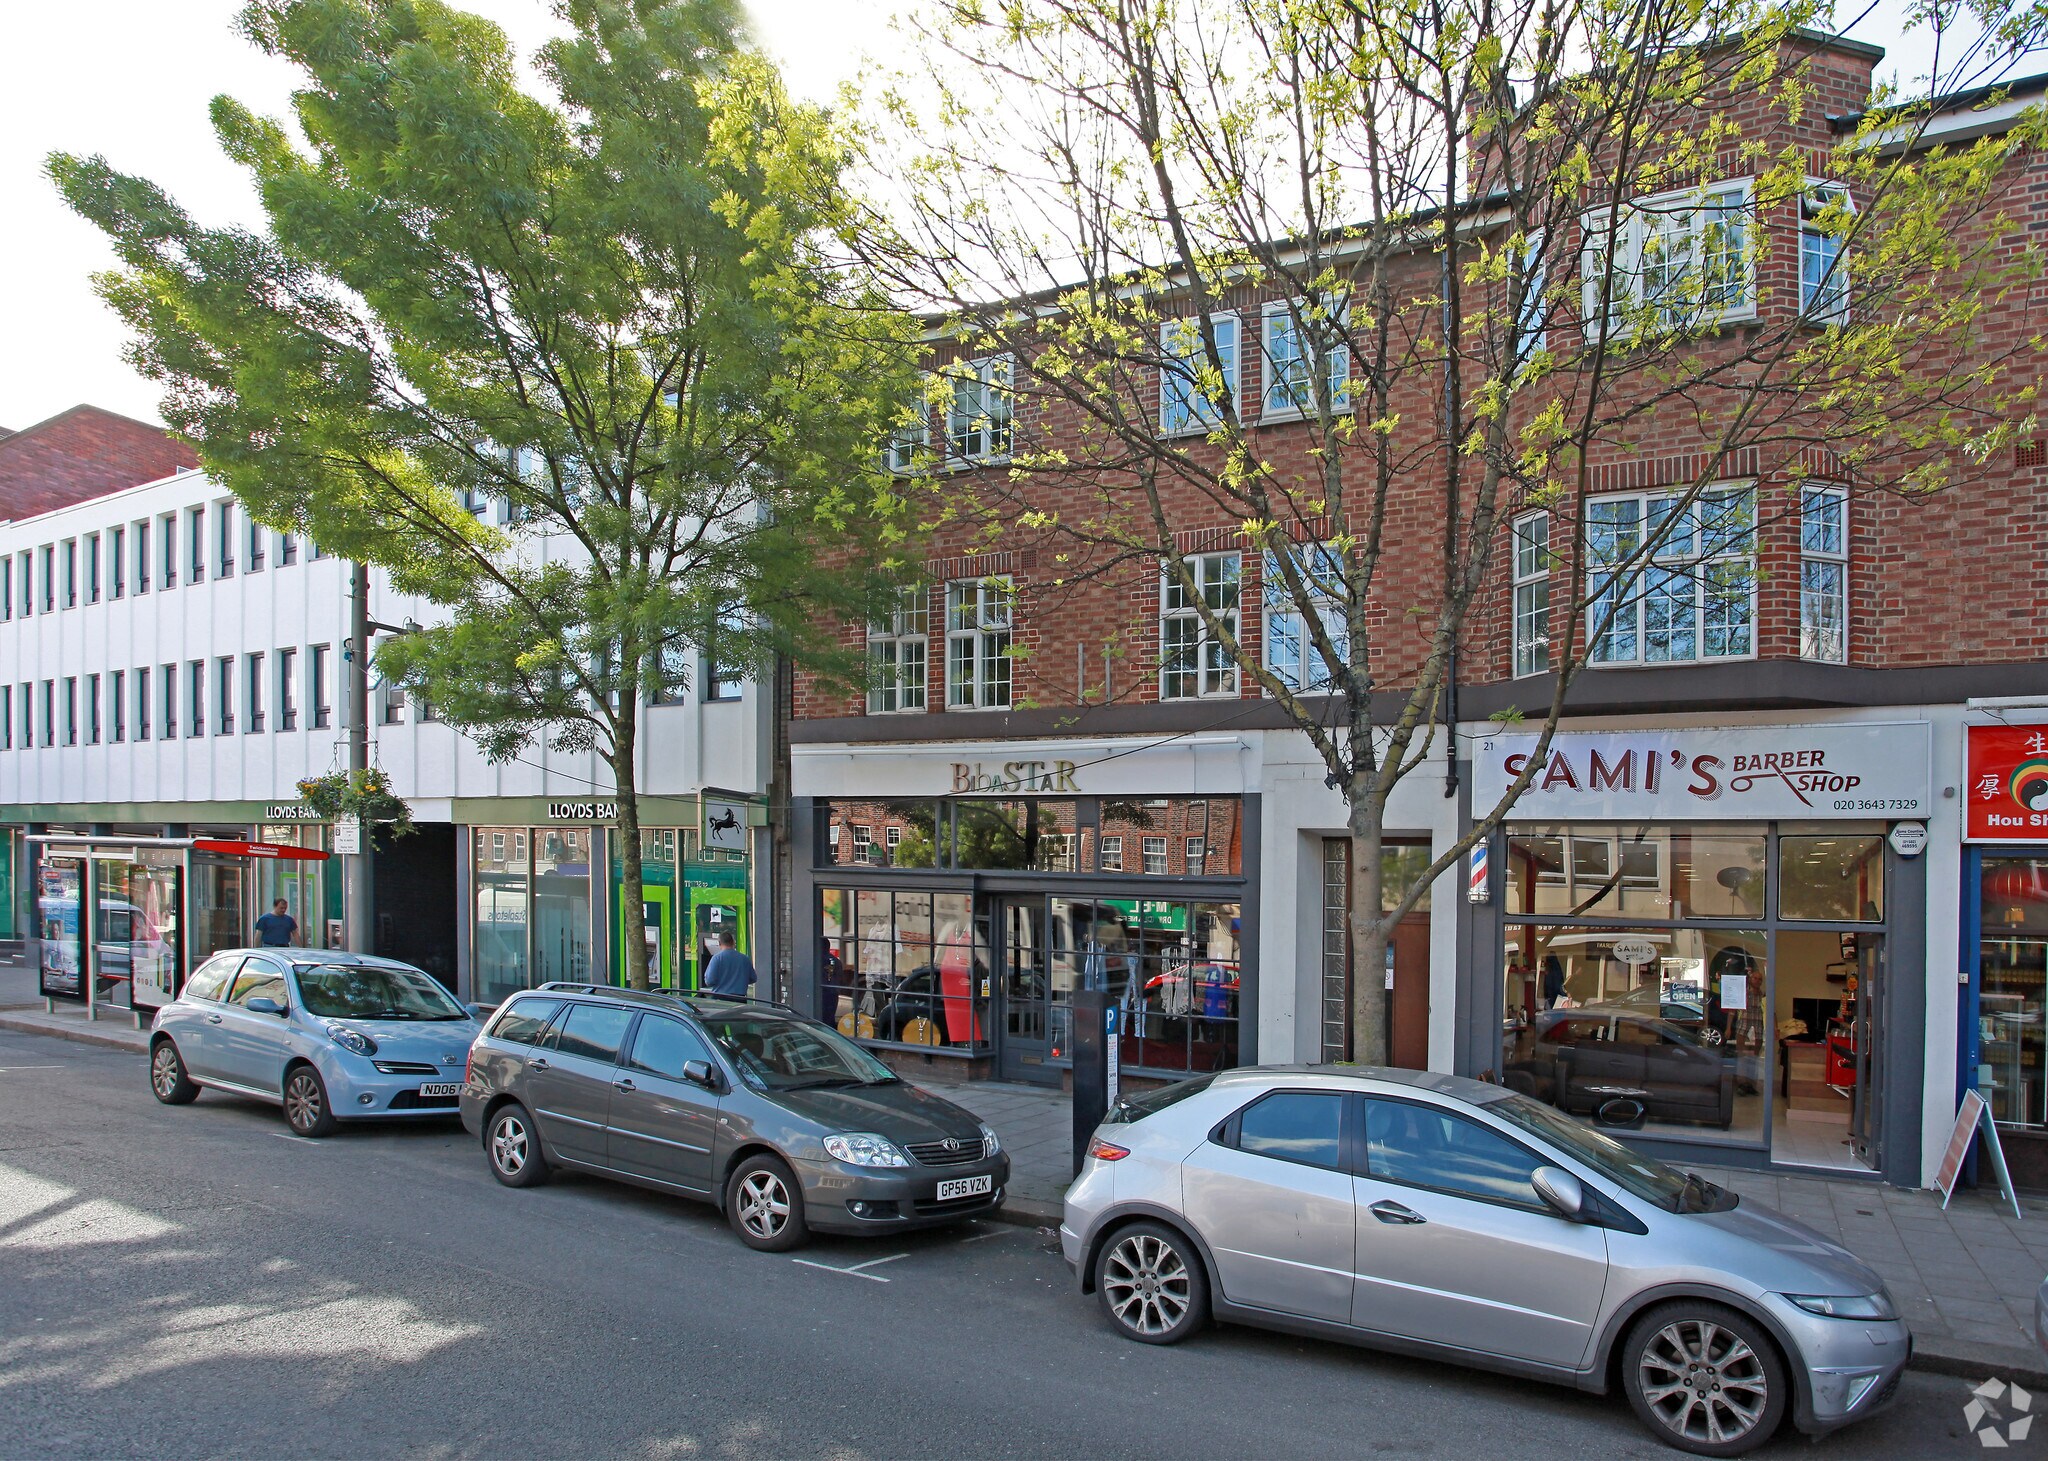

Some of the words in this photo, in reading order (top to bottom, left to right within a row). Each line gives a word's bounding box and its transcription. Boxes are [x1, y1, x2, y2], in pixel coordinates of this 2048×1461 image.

[1483, 741, 1494, 751] 21
[1733, 750, 1825, 772] BARBER
[1503, 749, 1726, 802] SAMI'S
[1797, 775, 1861, 792] SHOP
[1975, 774, 2000, 800] 厚
[266, 806, 297, 819] LLOYDS
[548, 803, 594, 819] LLOYDS
[1833, 800, 1855, 810] 020
[1857, 800, 1885, 810] 3643
[1889, 800, 1917, 809] 7329
[1987, 814, 2023, 826] Hou
[1107, 1009, 1114, 1029] P
[425, 1085, 456, 1094] ND06
[941, 1181, 967, 1197] GP56
[970, 1177, 988, 1192] VZK
